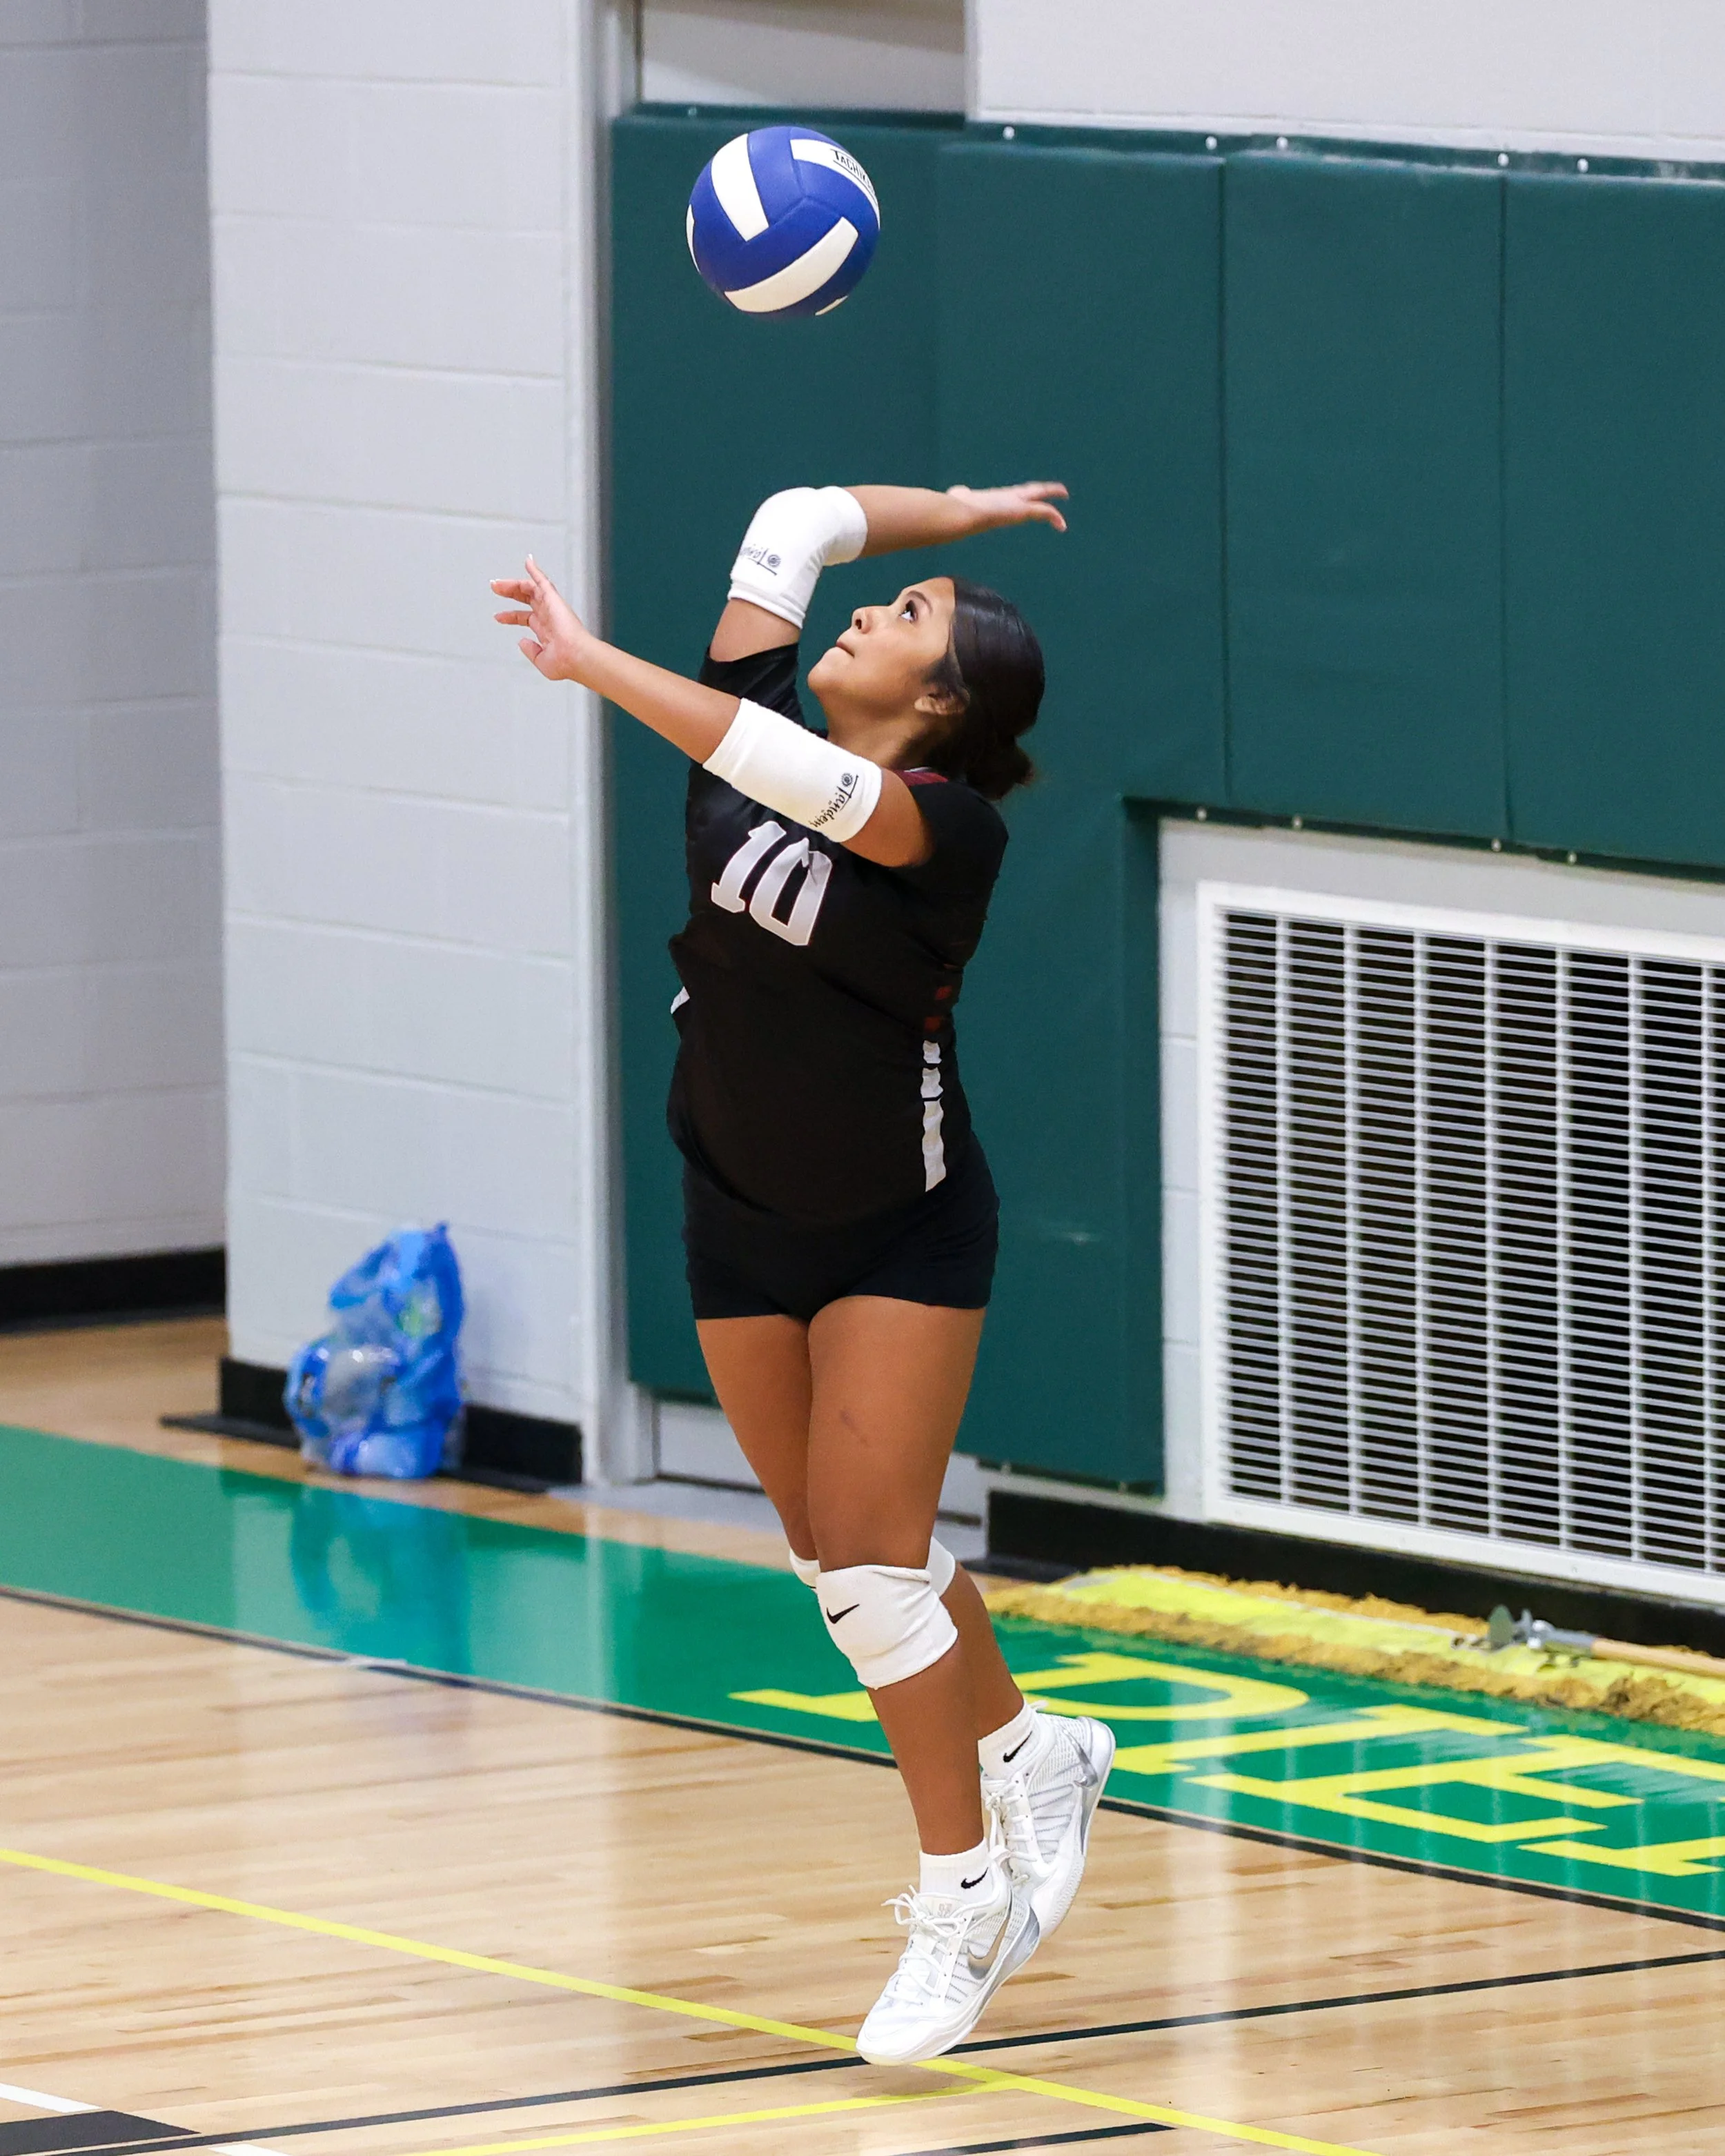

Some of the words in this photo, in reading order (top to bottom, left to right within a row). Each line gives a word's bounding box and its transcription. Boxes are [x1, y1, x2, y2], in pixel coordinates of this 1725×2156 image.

[809, 775, 858, 828] Tandem
[711, 820, 833, 946] 10
[727, 1652, 1725, 1877] PIE
